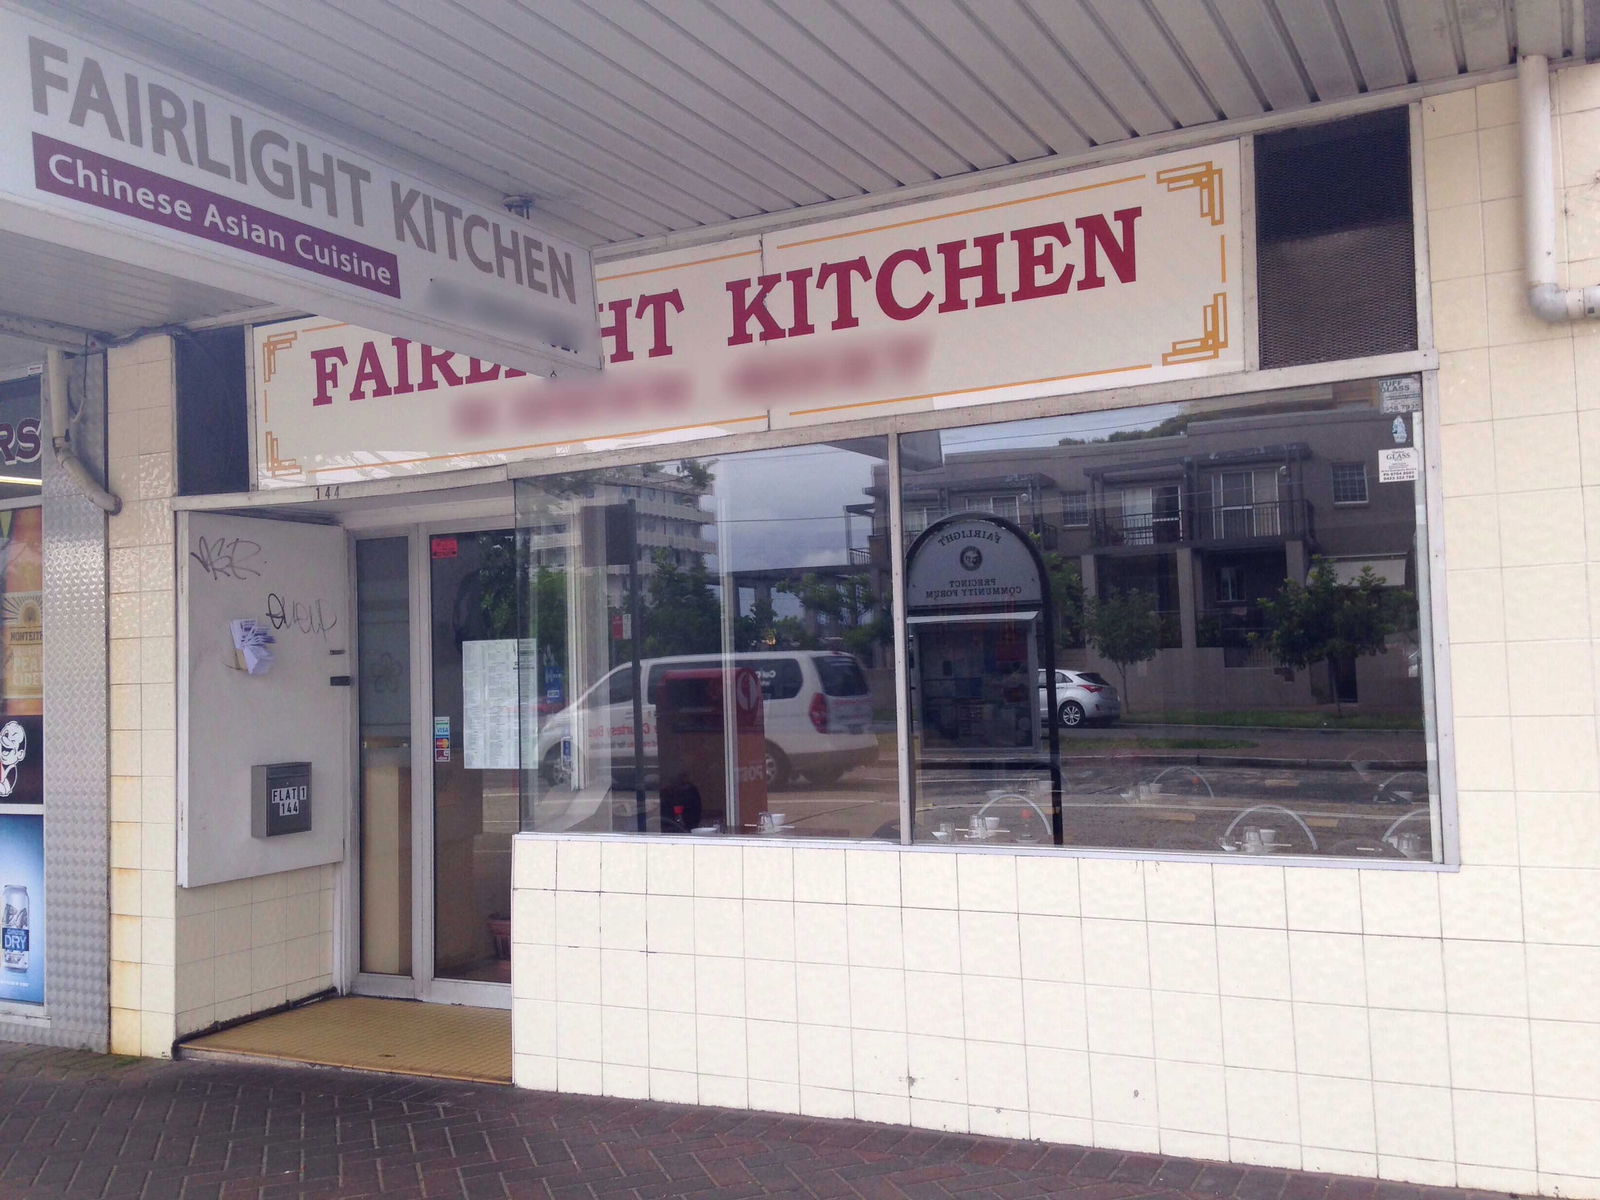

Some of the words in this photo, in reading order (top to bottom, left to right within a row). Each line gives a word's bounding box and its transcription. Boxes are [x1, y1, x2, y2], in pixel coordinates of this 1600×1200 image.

[27, 35, 371, 227] FAIRLIGHT
[389, 180, 577, 304] KITCHEN
[48, 152, 193, 221] Chinese
[203, 203, 285, 252] Asian
[294, 233, 391, 286] Cuisine
[310, 288, 685, 407] FAIRLHT
[725, 206, 1142, 346] KITCHEN
[316, 486, 340, 500] 144
[273, 788, 297, 802] FLAT
[281, 802, 298, 814] 144
[5, 934, 27, 950] DRY
